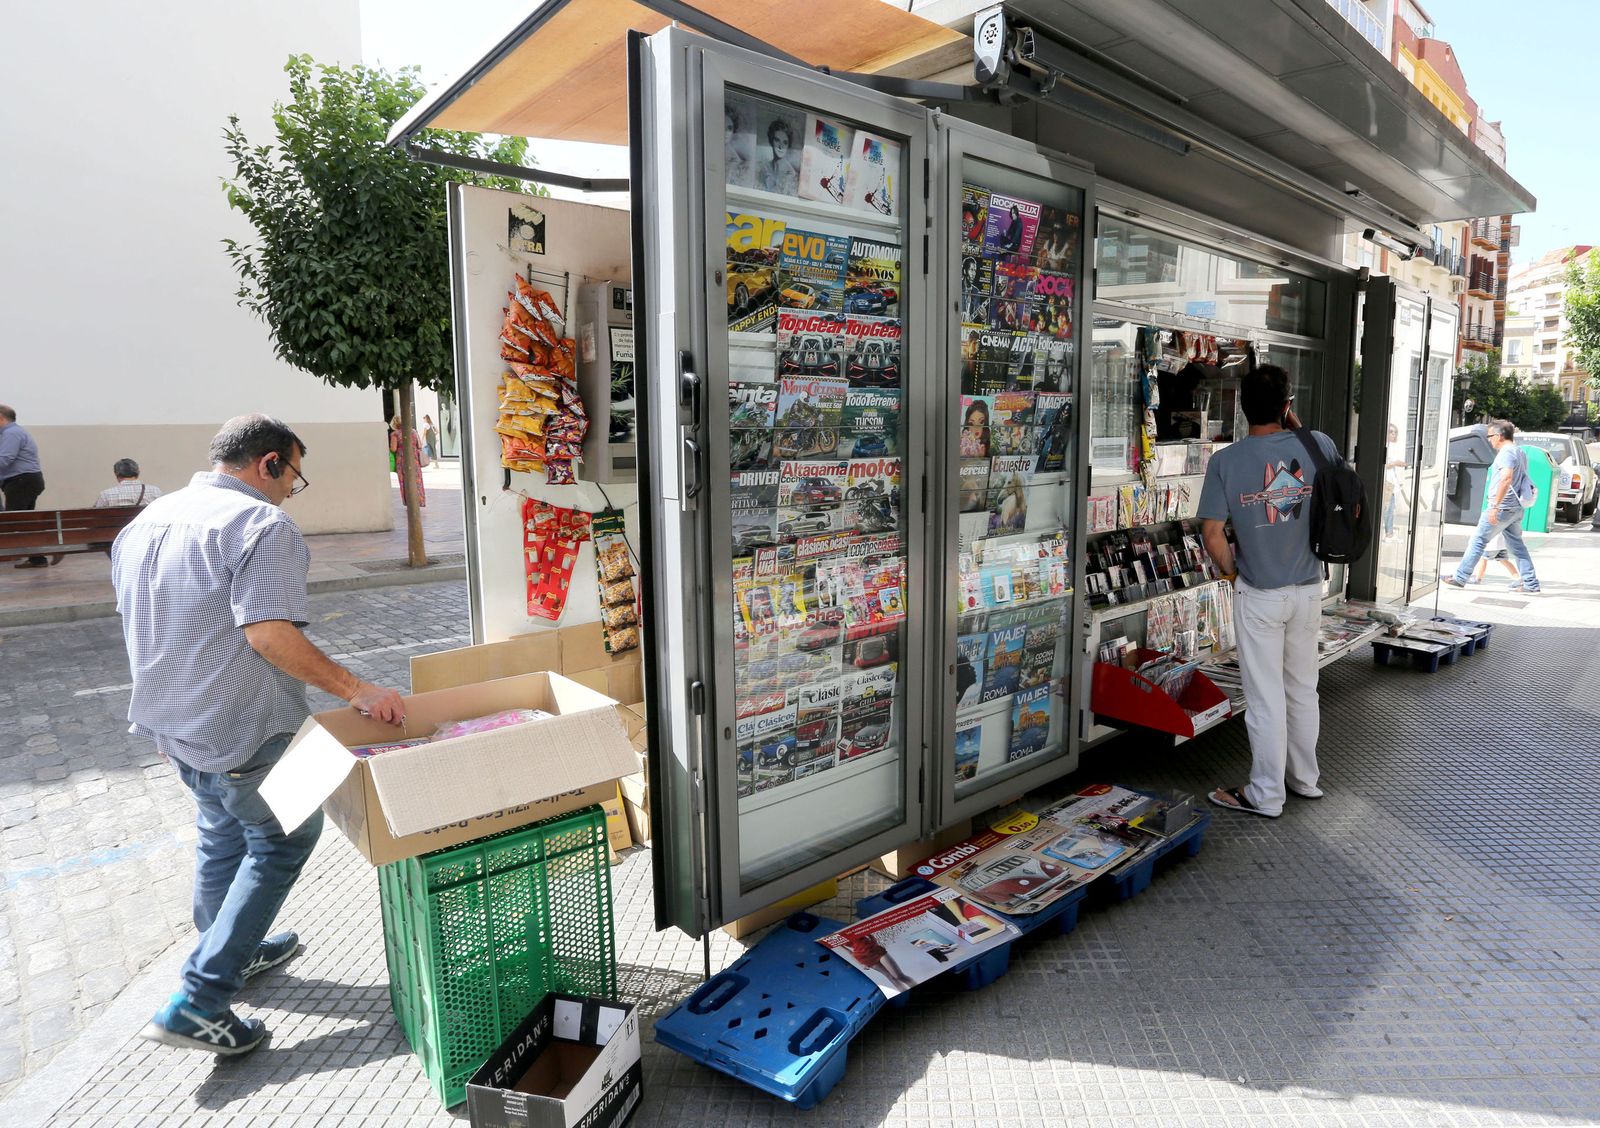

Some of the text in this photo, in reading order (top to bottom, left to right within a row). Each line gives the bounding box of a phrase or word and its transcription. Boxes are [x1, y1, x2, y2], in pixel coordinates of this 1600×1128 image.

[726, 213, 786, 254] ar
[783, 233, 825, 260] evo
[779, 313, 846, 334] TopGear
[846, 319, 902, 339] TopGear
[845, 392, 897, 408] TodoTerreno
[992, 455, 1031, 473] Ecuestre
[739, 471, 779, 486] DRIVER
[993, 624, 1027, 645] VIAJES
[983, 685, 1008, 701] ROMA
[1016, 686, 1049, 705] VIAJES
[757, 711, 796, 729] Clásicos
[1009, 745, 1034, 761] ROMA
[928, 842, 981, 869] Combi
